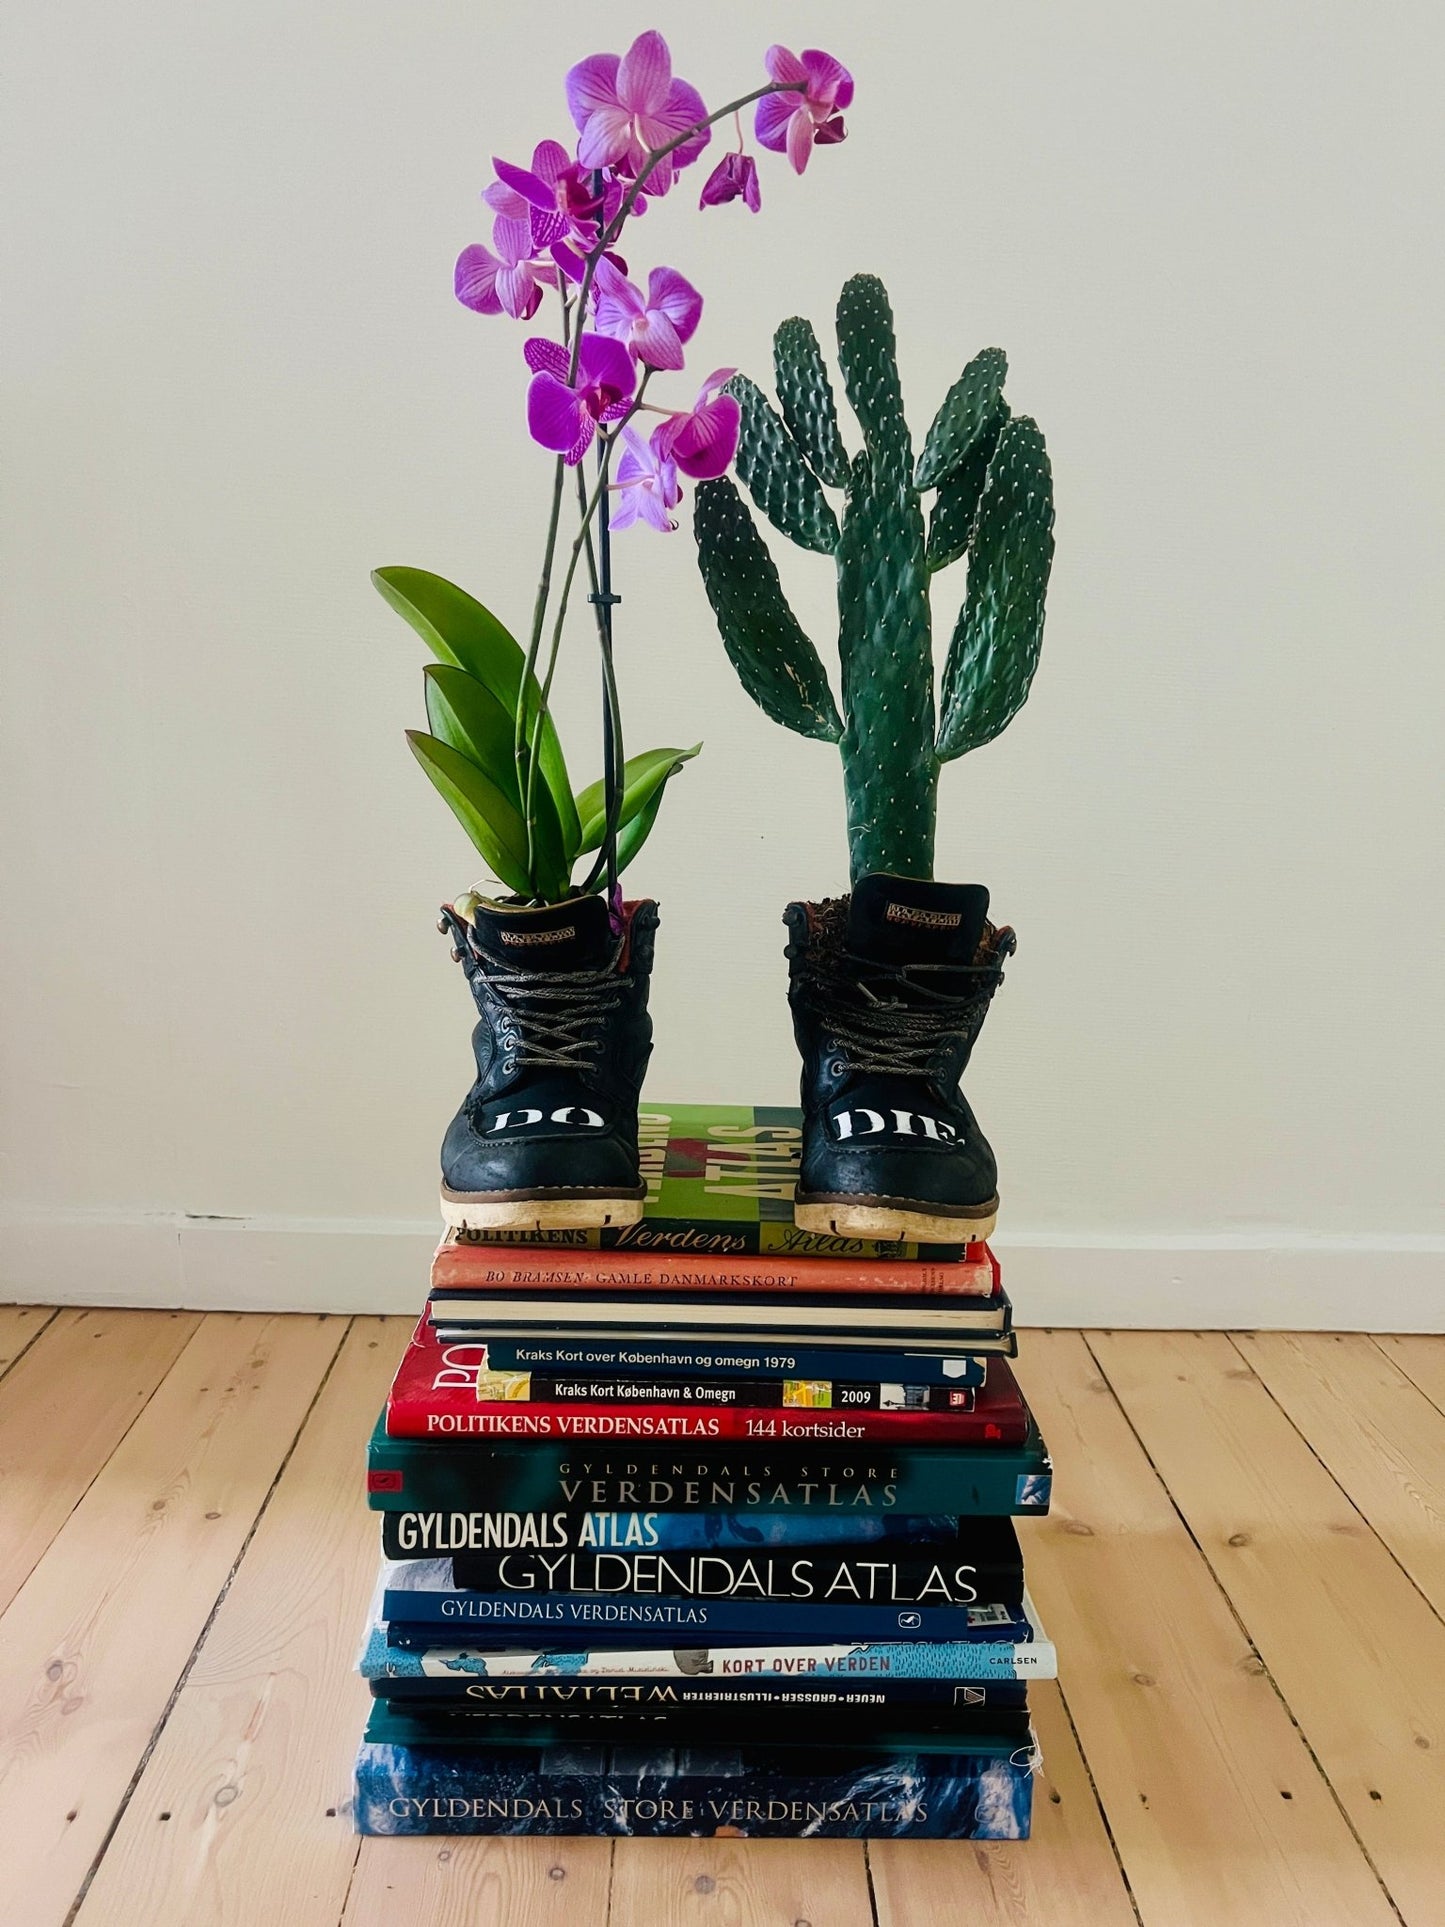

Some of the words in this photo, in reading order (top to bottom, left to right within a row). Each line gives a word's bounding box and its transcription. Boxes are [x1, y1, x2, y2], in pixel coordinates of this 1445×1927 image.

[486, 1106, 604, 1134] DO
[833, 1108, 965, 1145] DIE
[613, 1223, 745, 1250] Verdens
[485, 1271, 505, 1282] BO
[596, 1273, 652, 1285] GAMLE
[659, 1273, 798, 1287] DANMARKSKORT
[516, 1349, 553, 1361] Kraks
[556, 1349, 584, 1362] Kort
[586, 1352, 616, 1363] over
[619, 1351, 692, 1366] København
[695, 1356, 712, 1367] og
[715, 1356, 760, 1369] omegn
[764, 1356, 796, 1369] 1979
[555, 1383, 588, 1397] Kraks
[590, 1383, 614, 1397] Kort
[617, 1384, 680, 1400] København
[683, 1386, 693, 1399] &
[696, 1386, 736, 1402] Omegn
[841, 1390, 871, 1404] 2009
[427, 1414, 551, 1433] POLITIKENS
[557, 1416, 720, 1436] VERDENSATLAS
[746, 1419, 776, 1437] 144
[782, 1420, 866, 1438] kortsider
[559, 1463, 772, 1476] GYLDENDALS
[801, 1466, 898, 1479] STORE
[558, 1480, 898, 1507] VERDENSATLAS
[398, 1512, 568, 1550] GYLDENDALS
[578, 1512, 659, 1548] ATLAS
[498, 1553, 814, 1597] GYLDENDALS
[824, 1561, 978, 1603] ATLAS
[441, 1600, 564, 1619] GYLDENDALS
[570, 1604, 708, 1623] VERDENSATLAS
[722, 1659, 765, 1674] KORT
[773, 1658, 817, 1673] OVER
[825, 1656, 891, 1672] VERDEN
[989, 1657, 1038, 1665] CARLSEN
[683, 1692, 772, 1702] ILLUSTRIERTER
[782, 1694, 837, 1704] GROSSER
[846, 1694, 885, 1704] NEUER
[388, 1797, 583, 1818] GYLDENDALS
[604, 1799, 694, 1819] STORE
[708, 1800, 928, 1823] VERDENSATLAS
